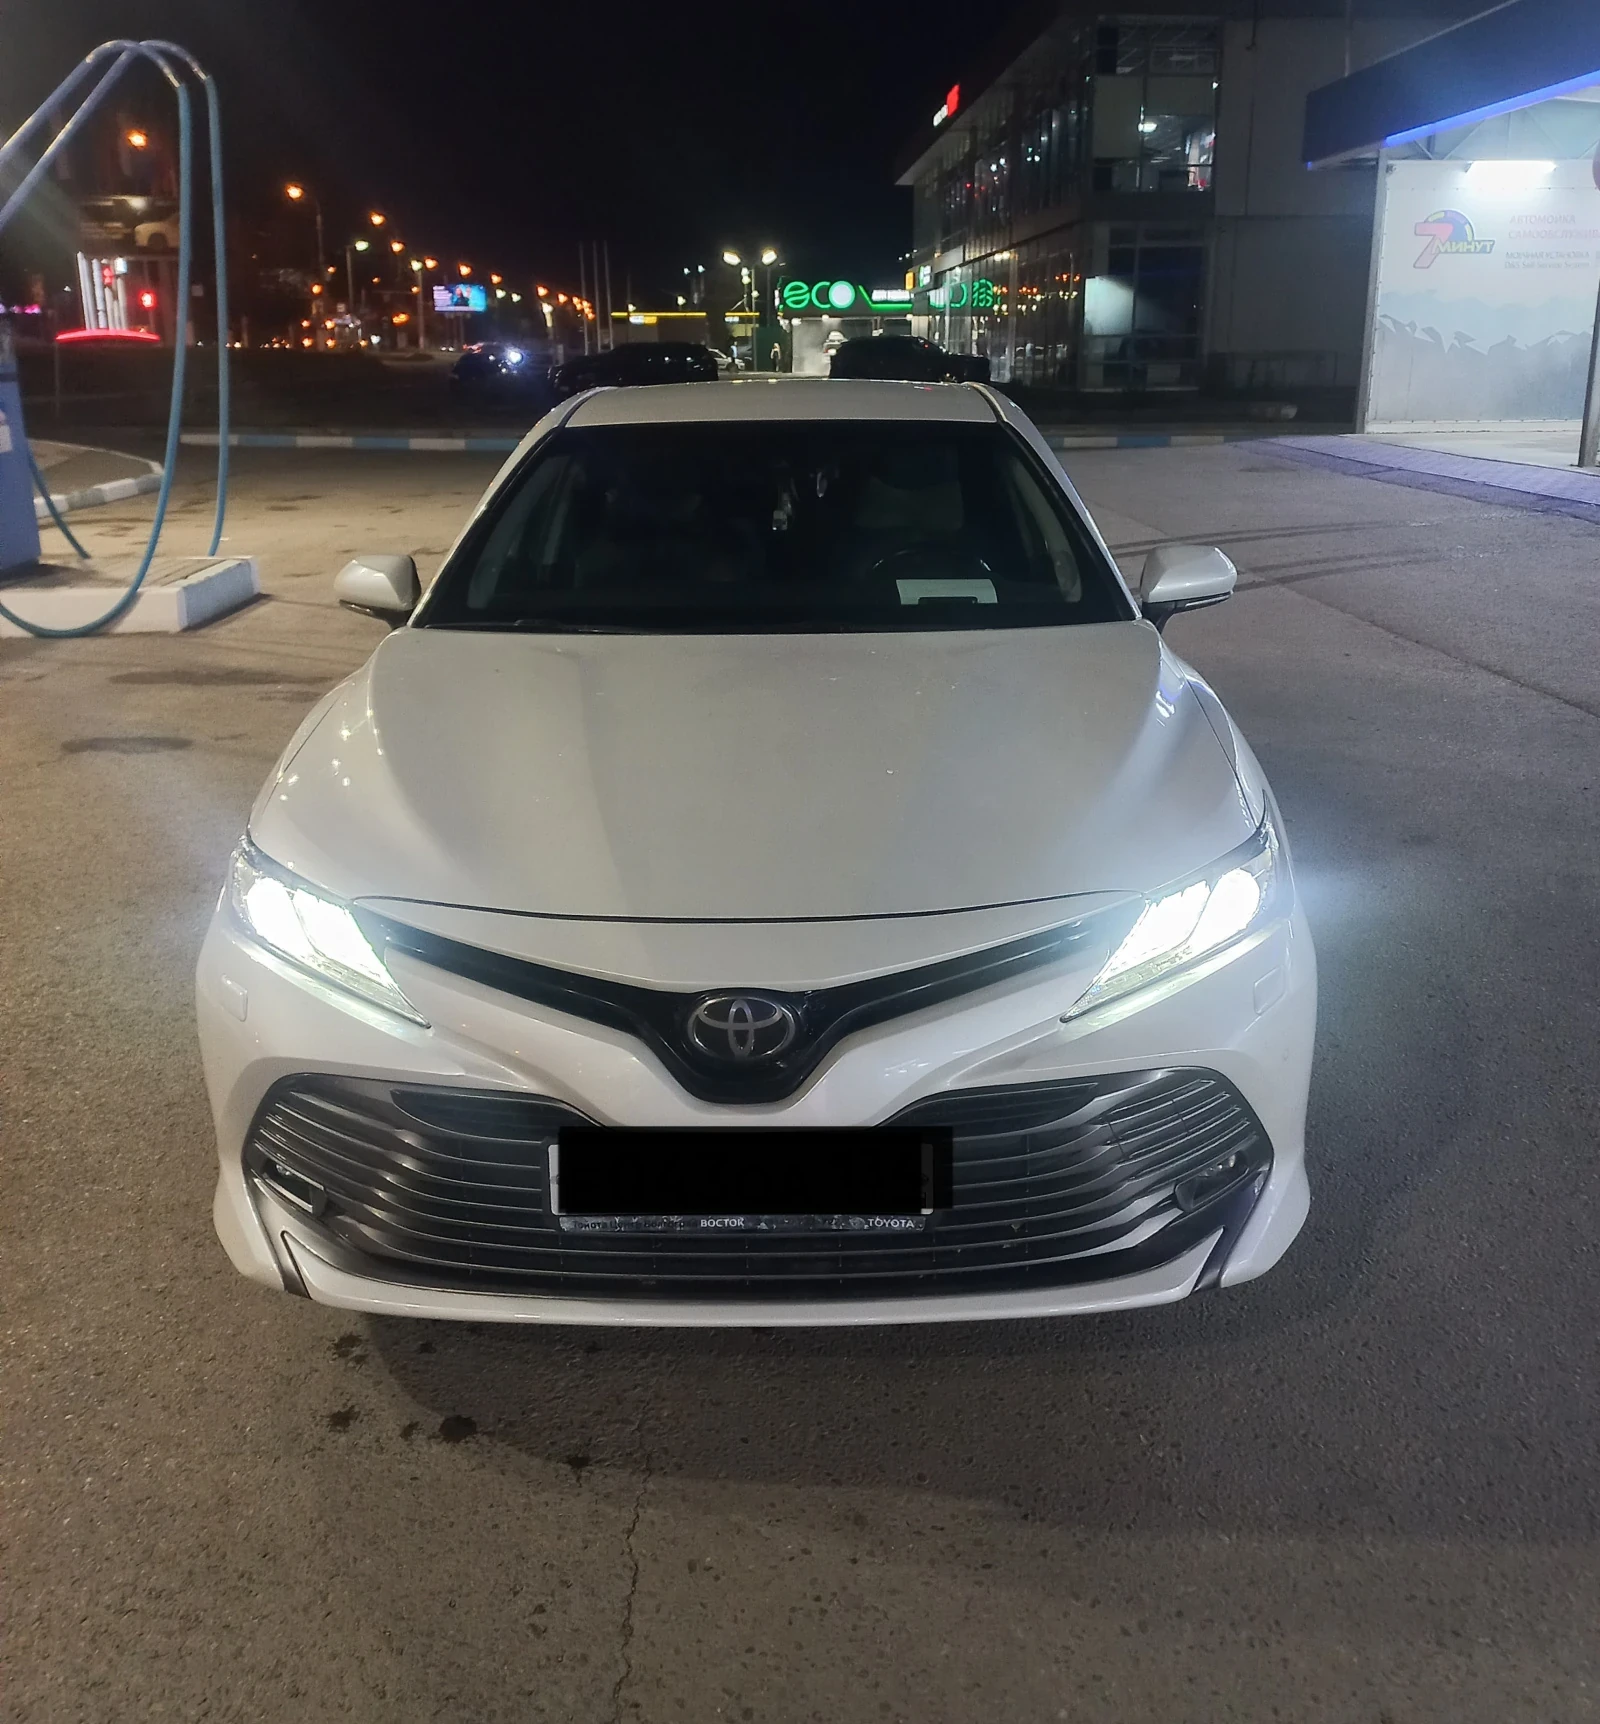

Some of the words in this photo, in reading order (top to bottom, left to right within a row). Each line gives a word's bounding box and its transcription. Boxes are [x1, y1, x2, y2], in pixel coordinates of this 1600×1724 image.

[1413, 222, 1454, 269] 7
[1431, 239, 1494, 254] МИНУТ
[700, 1217, 745, 1229] ВОСТОК
[867, 1217, 915, 1229] TOYOTA
